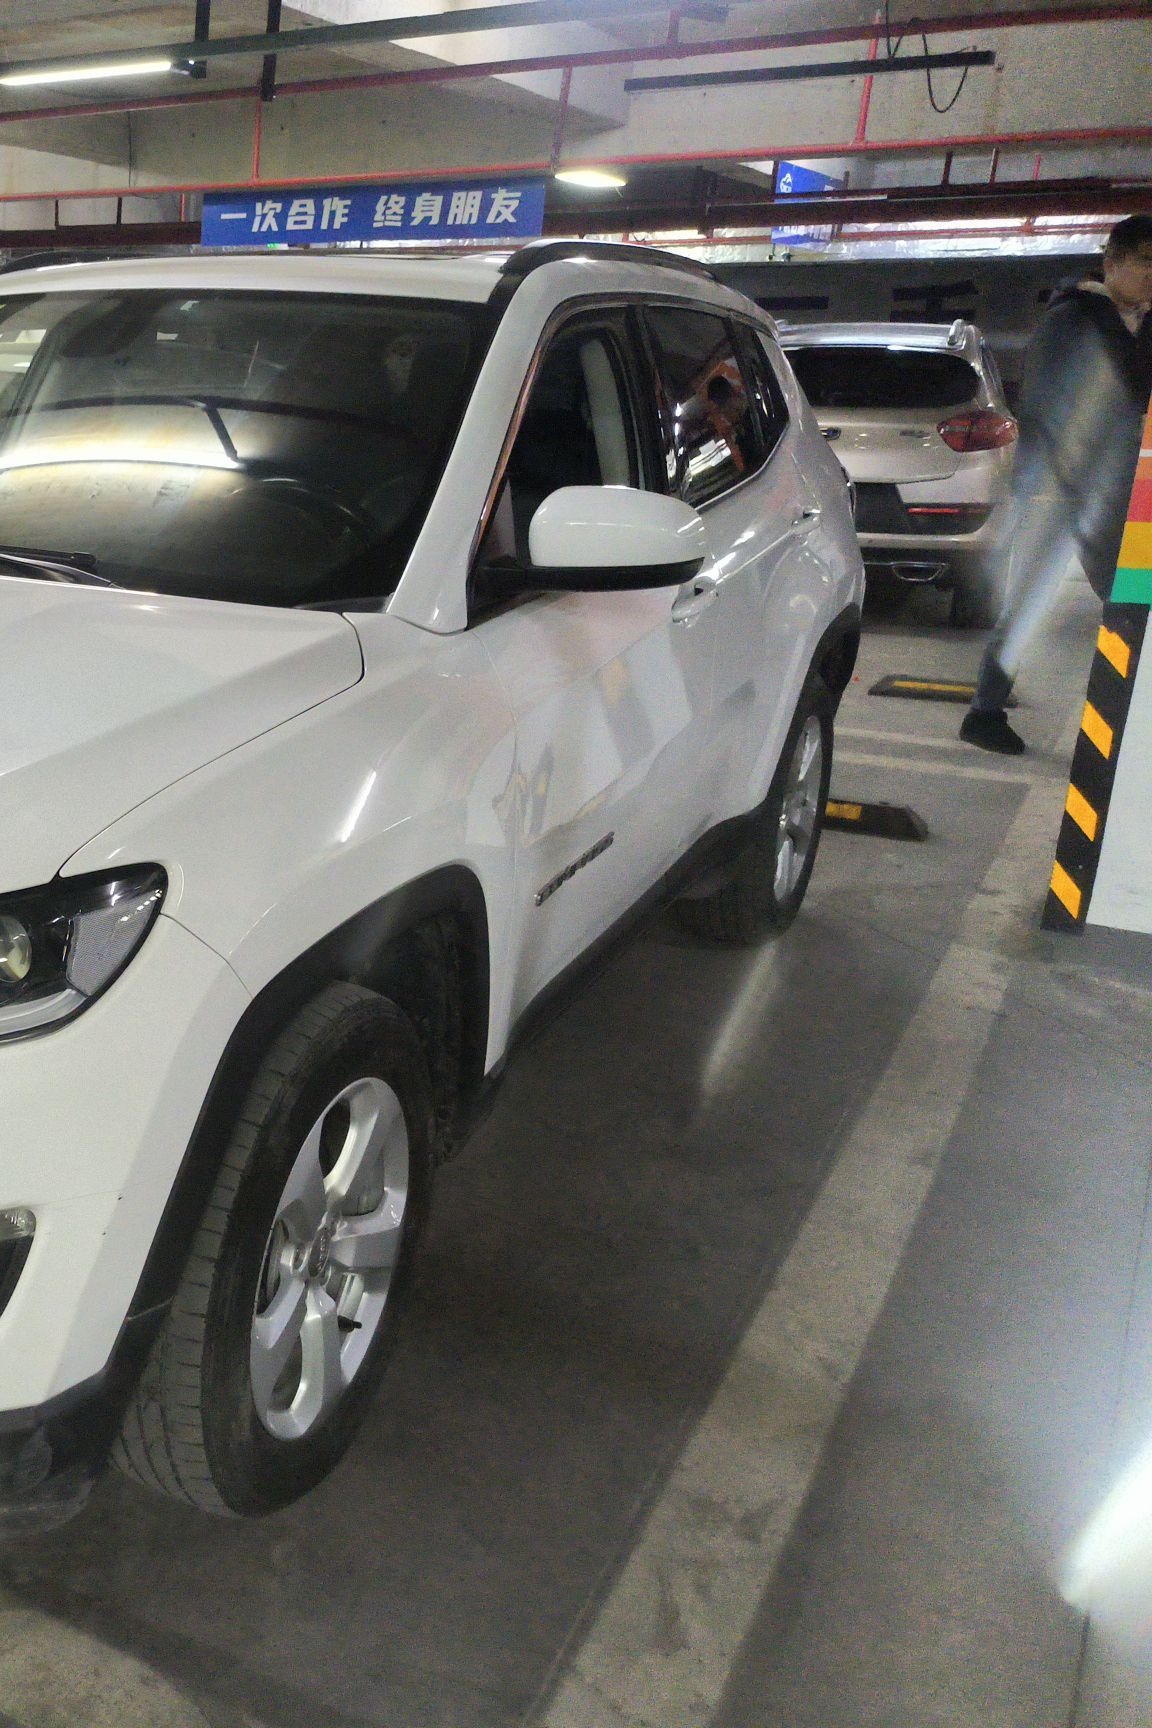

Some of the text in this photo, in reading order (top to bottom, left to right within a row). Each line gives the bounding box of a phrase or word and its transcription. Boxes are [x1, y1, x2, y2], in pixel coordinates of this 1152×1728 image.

[220, 188, 522, 232] 一次合作 终身朋友
